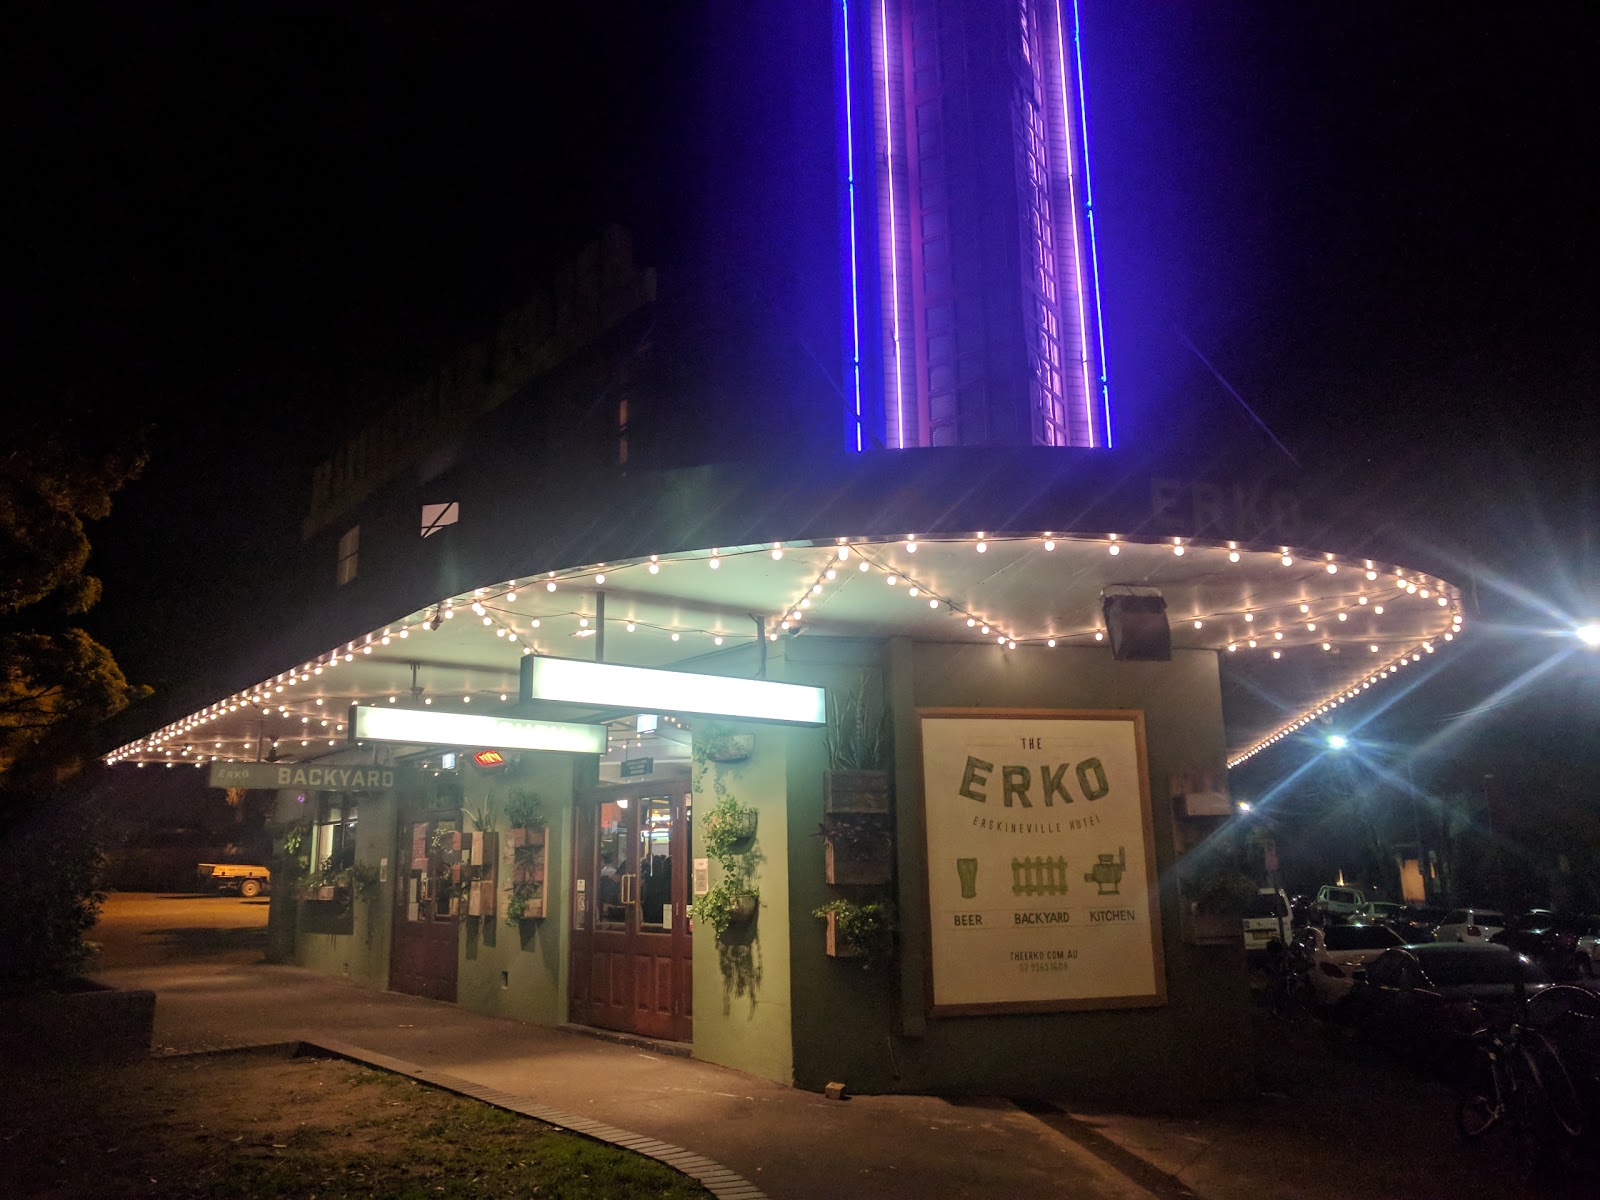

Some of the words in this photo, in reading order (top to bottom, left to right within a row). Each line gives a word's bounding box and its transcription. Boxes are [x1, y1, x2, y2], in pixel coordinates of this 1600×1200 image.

[1020, 737, 1043, 750] THE
[217, 769, 250, 779] ERKO
[278, 767, 393, 787] BACKYARD
[958, 755, 1110, 808] ERKO
[972, 816, 1061, 833] ERSKINEVILLE
[1069, 814, 1101, 830] HOTEL
[954, 914, 983, 926] BEER
[1014, 912, 1070, 925] BACKYARD
[1090, 909, 1136, 922] KITCHEN
